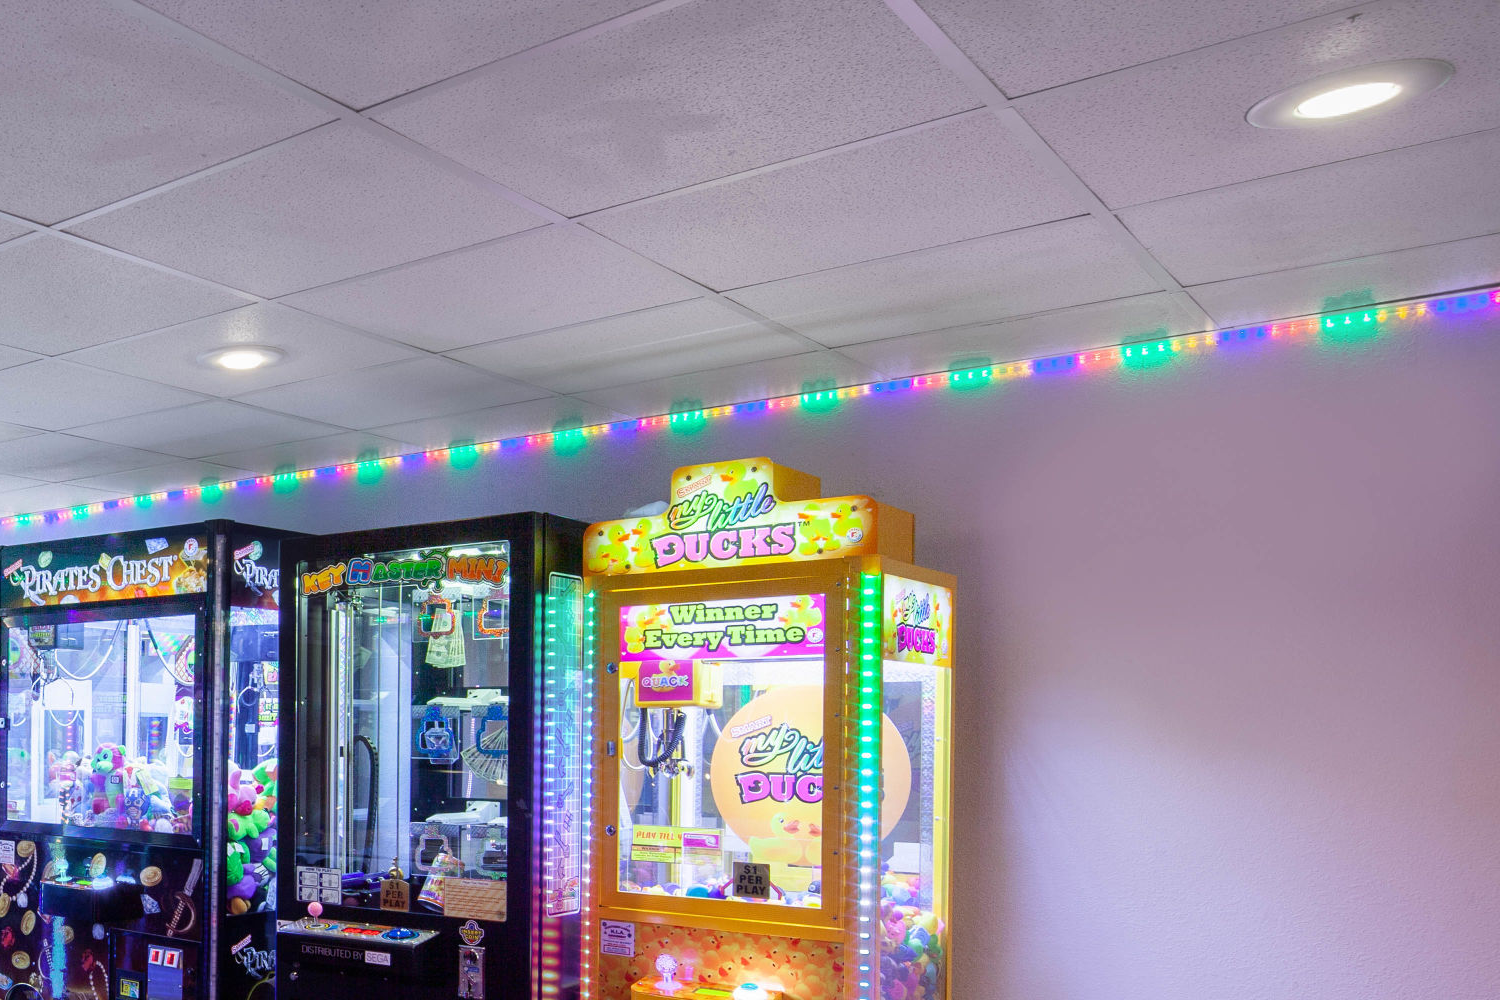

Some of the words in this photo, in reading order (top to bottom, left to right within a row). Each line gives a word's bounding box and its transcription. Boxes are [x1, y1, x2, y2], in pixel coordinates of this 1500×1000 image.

[707, 482, 776, 531] little
[650, 522, 797, 569] DUCKS
[17, 563, 101, 606] PIRATES
[106, 555, 174, 591] CHEST
[302, 563, 346, 595] KEY
[447, 555, 509, 586] MINI
[669, 603, 778, 625] Winner
[644, 628, 724, 652] Every
[725, 624, 806, 646] Time
[896, 622, 936, 655] DUCKS
[642, 674, 690, 688] QUACK
[787, 736, 823, 774] lit
[734, 770, 823, 804] DUC
[736, 885, 766, 895] PLAY
[740, 875, 763, 884] PER
[383, 899, 406, 908] PLAY
[386, 890, 404, 898] PER
[301, 945, 351, 959] DISTRIBUTED
[352, 951, 364, 961] BY
[365, 952, 390, 964] SEGA
